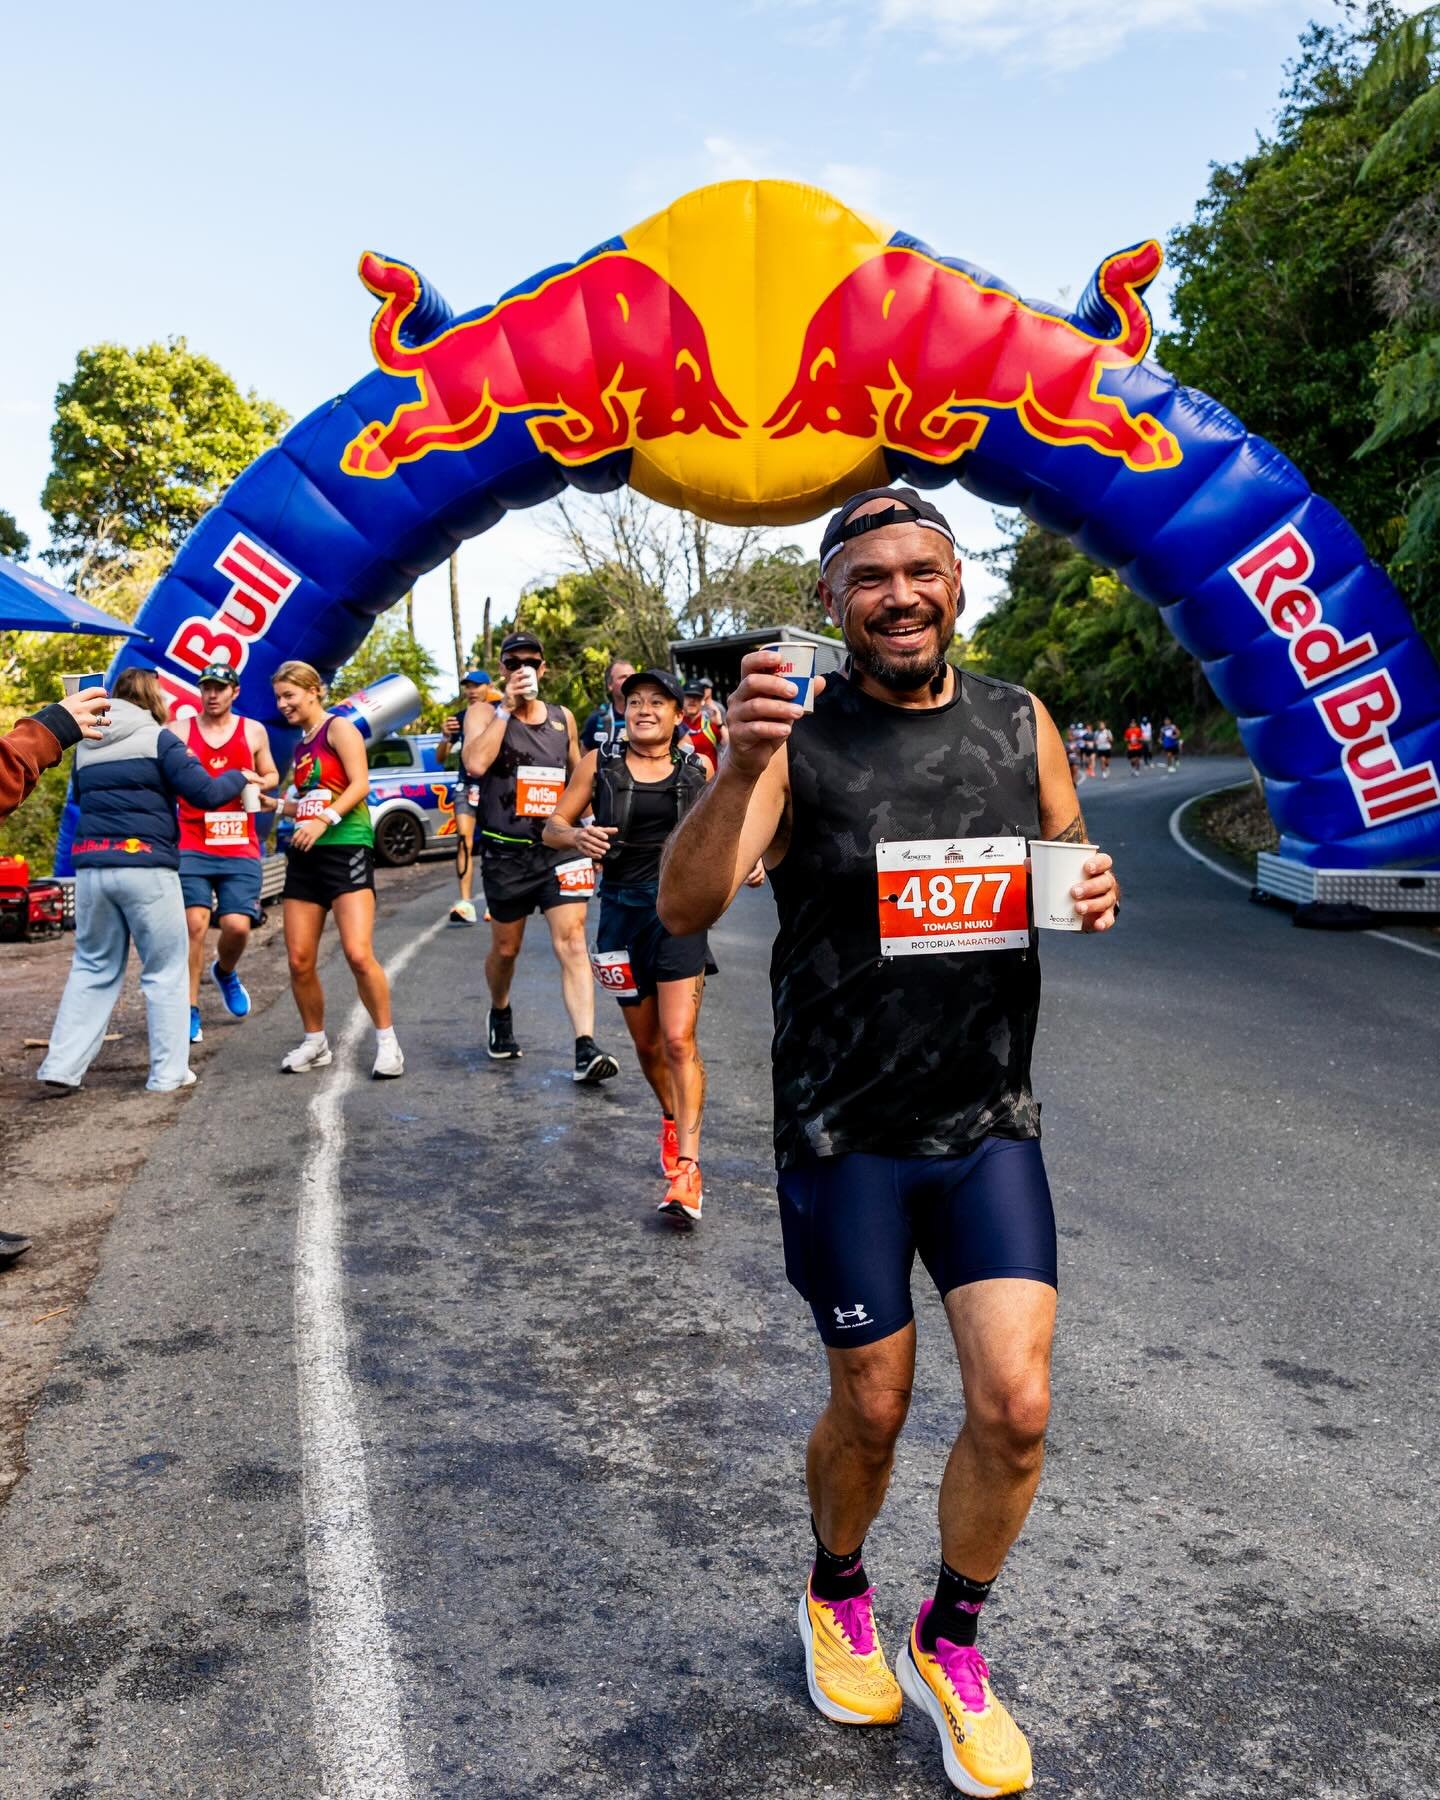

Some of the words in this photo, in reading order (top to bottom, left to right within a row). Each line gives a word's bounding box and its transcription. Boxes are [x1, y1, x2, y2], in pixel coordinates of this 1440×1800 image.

[168, 536, 296, 675] Bull
[1233, 527, 1375, 685] Red
[1317, 670, 1439, 824] Bull
[401, 784, 426, 797] Bull
[527, 787, 557, 803] 4h15m
[210, 822, 243, 835] 4912
[897, 872, 1011, 918] 4877
[922, 922, 962, 932] TOMASI
[965, 920, 993, 929] NUKU
[911, 940, 956, 950] ROTORUA
[957, 936, 1006, 947] MARATHON
